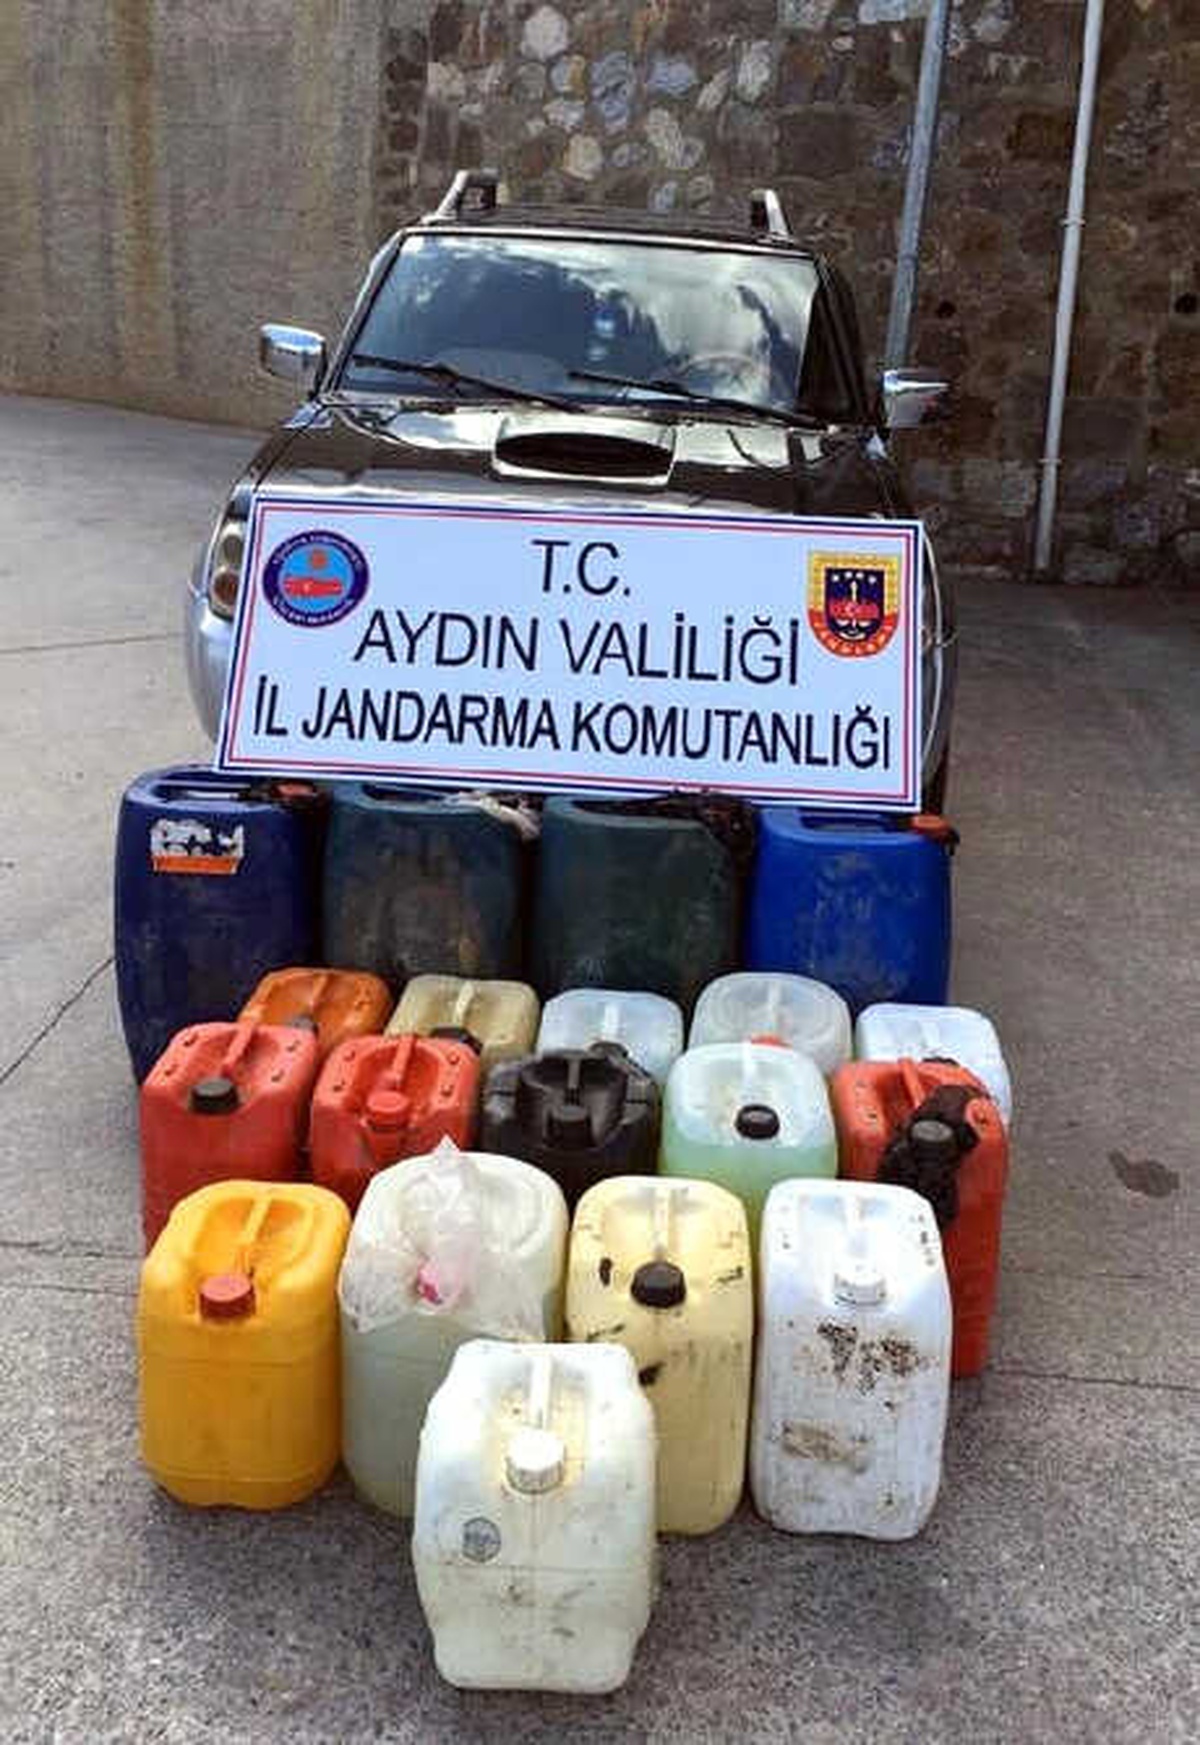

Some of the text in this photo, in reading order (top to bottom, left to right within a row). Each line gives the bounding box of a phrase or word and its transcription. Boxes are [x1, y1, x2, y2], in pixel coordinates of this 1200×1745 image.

[531, 539, 630, 597] T.C.
[353, 608, 539, 672] AYDIN
[559, 612, 799, 686] VALİLİĞİ
[253, 674, 890, 770] İL JANDARMA KOMUTANLIĞI
